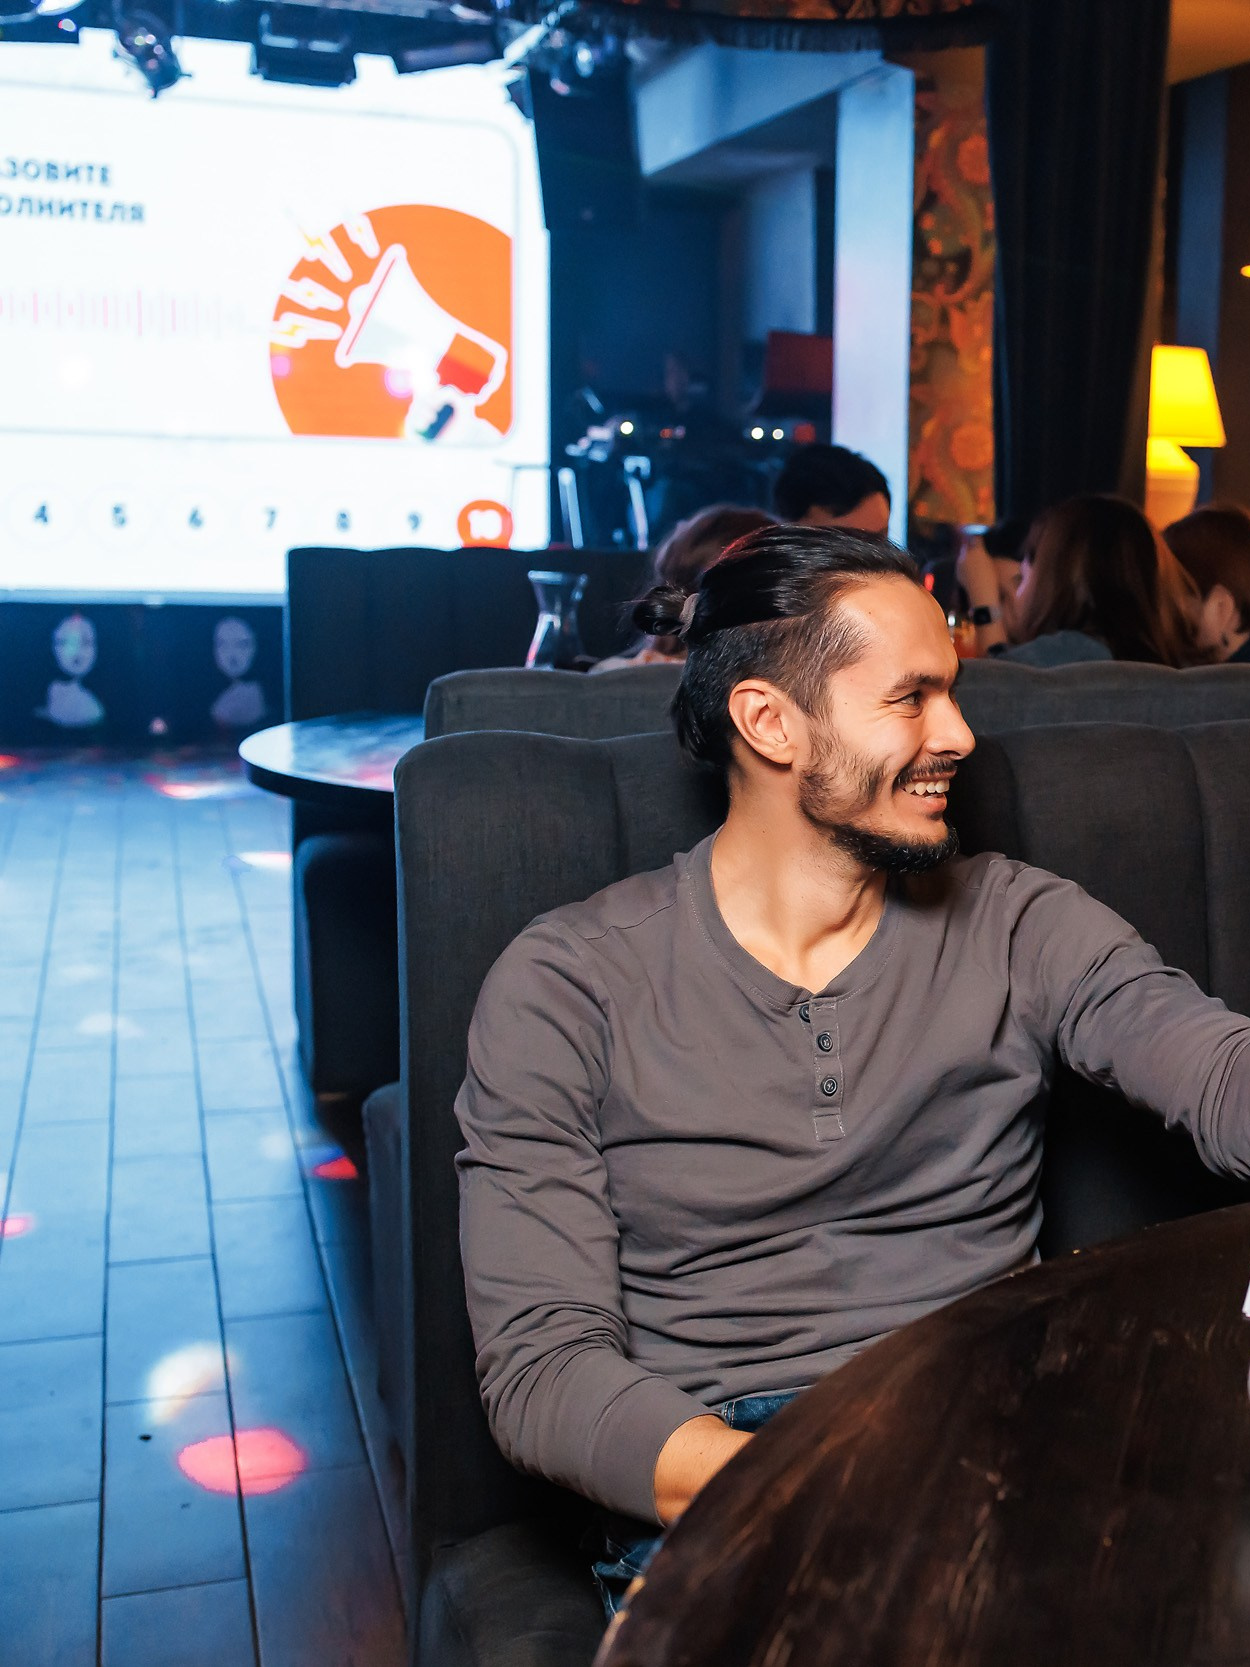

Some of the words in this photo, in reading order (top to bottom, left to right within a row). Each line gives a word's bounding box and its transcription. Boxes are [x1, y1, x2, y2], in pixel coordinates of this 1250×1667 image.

[0, 157, 111, 187] ЗОВИТЕ
[34, 502, 49, 525] 4
[112, 504, 127, 527] 5
[188, 508, 203, 528] 6
[265, 507, 278, 529] 7
[336, 511, 350, 532] 8
[408, 512, 422, 531] 9
